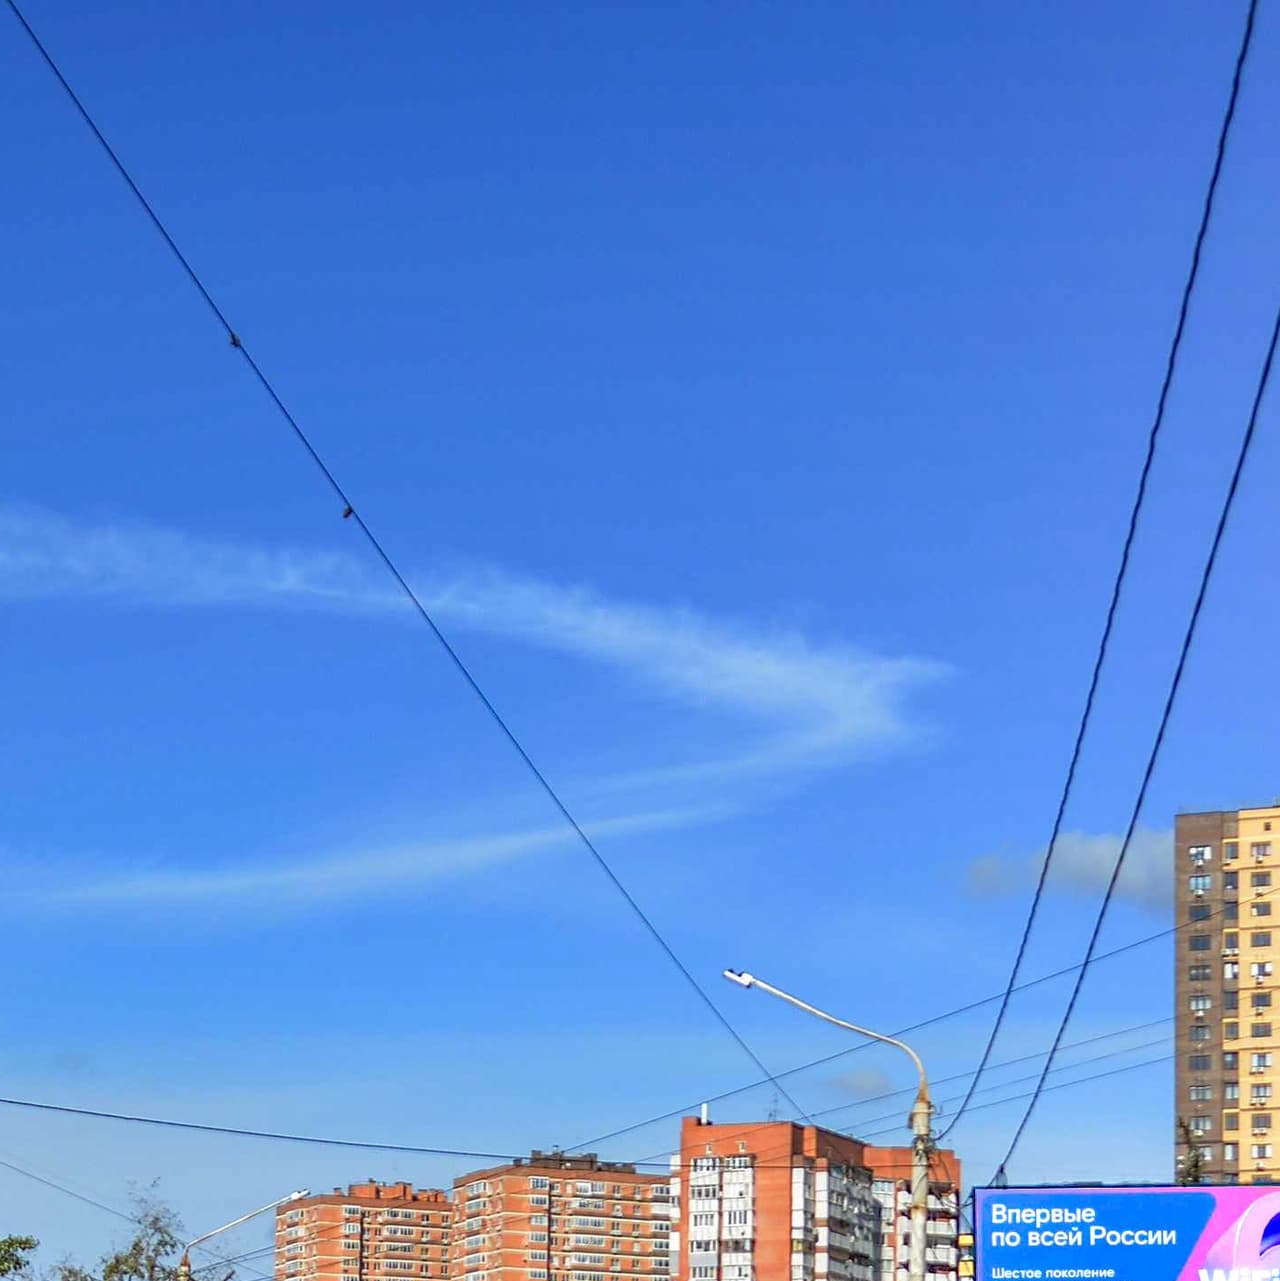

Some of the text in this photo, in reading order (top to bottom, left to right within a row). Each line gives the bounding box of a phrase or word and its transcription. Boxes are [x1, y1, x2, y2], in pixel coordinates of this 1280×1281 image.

[991, 1203, 1096, 1228] Впервые
[991, 1225, 1177, 1247] по всей России
[991, 1267, 1116, 1279] Шестое поколение
